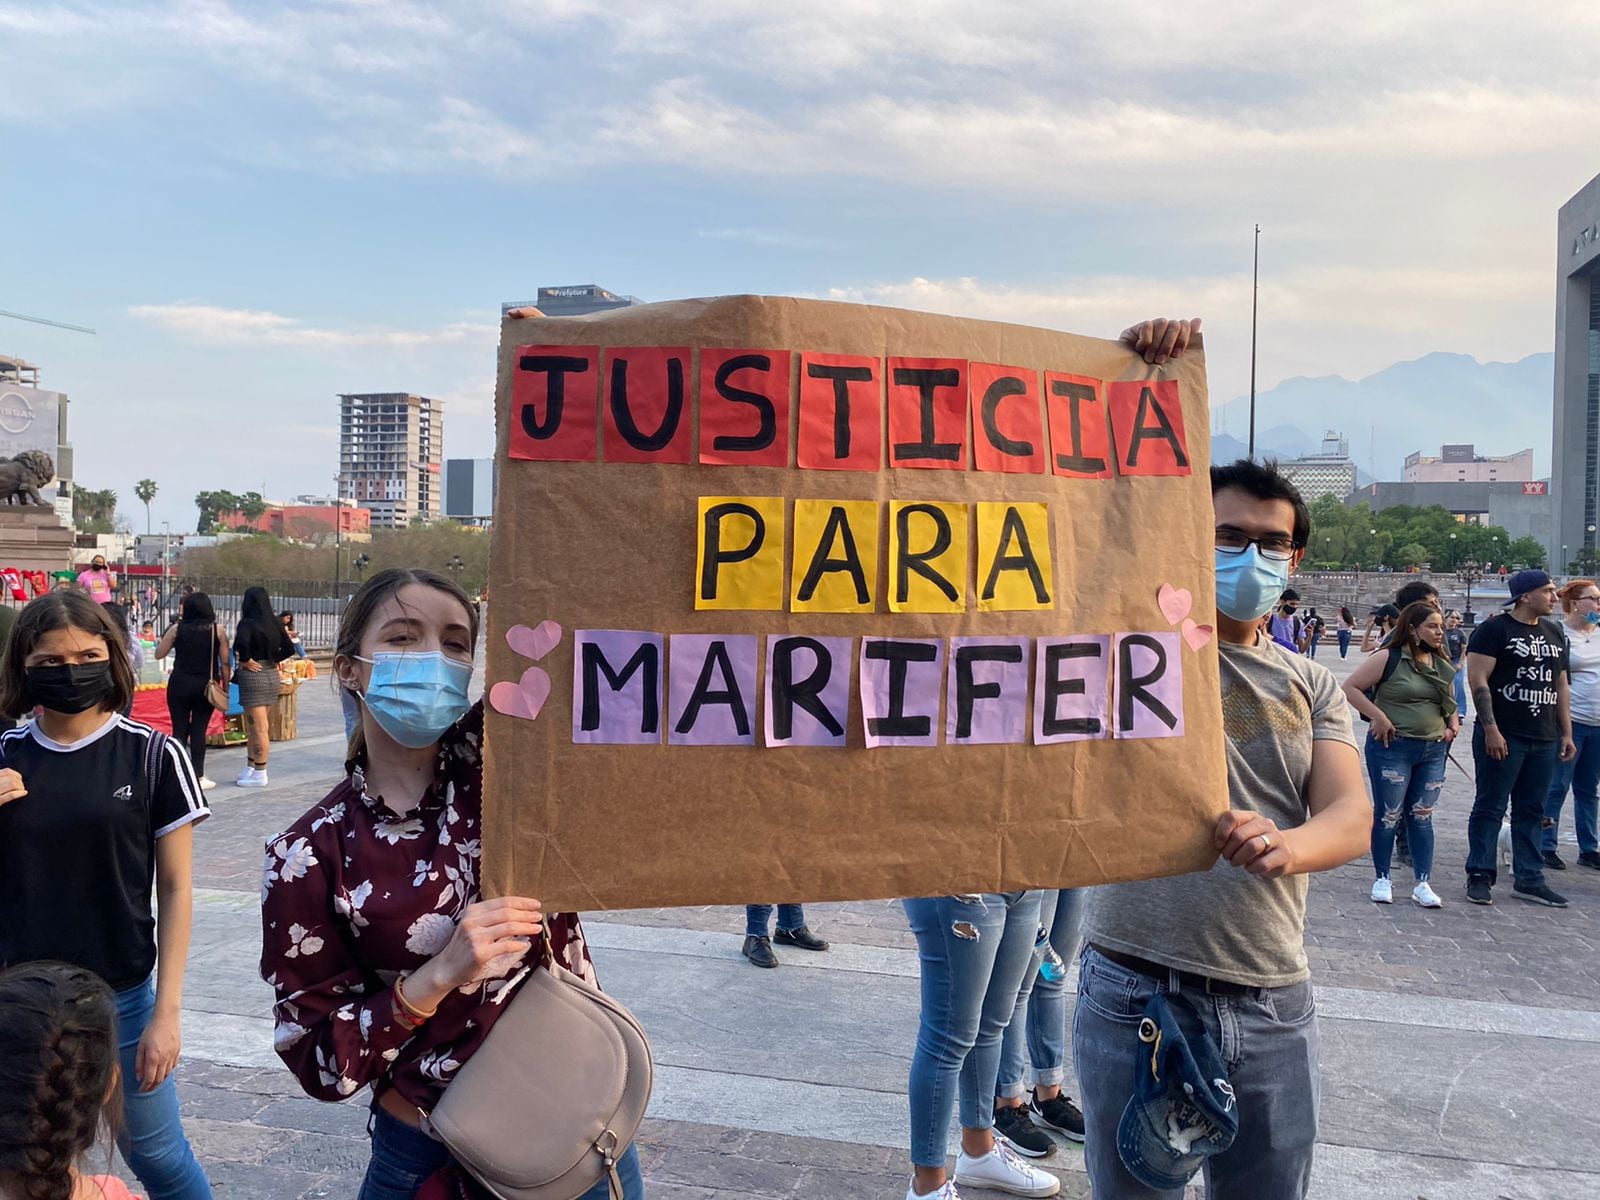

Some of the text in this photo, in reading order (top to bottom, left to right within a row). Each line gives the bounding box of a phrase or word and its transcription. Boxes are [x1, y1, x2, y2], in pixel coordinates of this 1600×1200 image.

[555, 288, 588, 297] Profuturo
[0, 408, 36, 418] ISSAN
[520, 354, 1190, 475] JUSTICIA
[701, 502, 1052, 605] PARA
[580, 633, 1177, 741] MARIFER
[1502, 682, 1558, 708] Cumbia
